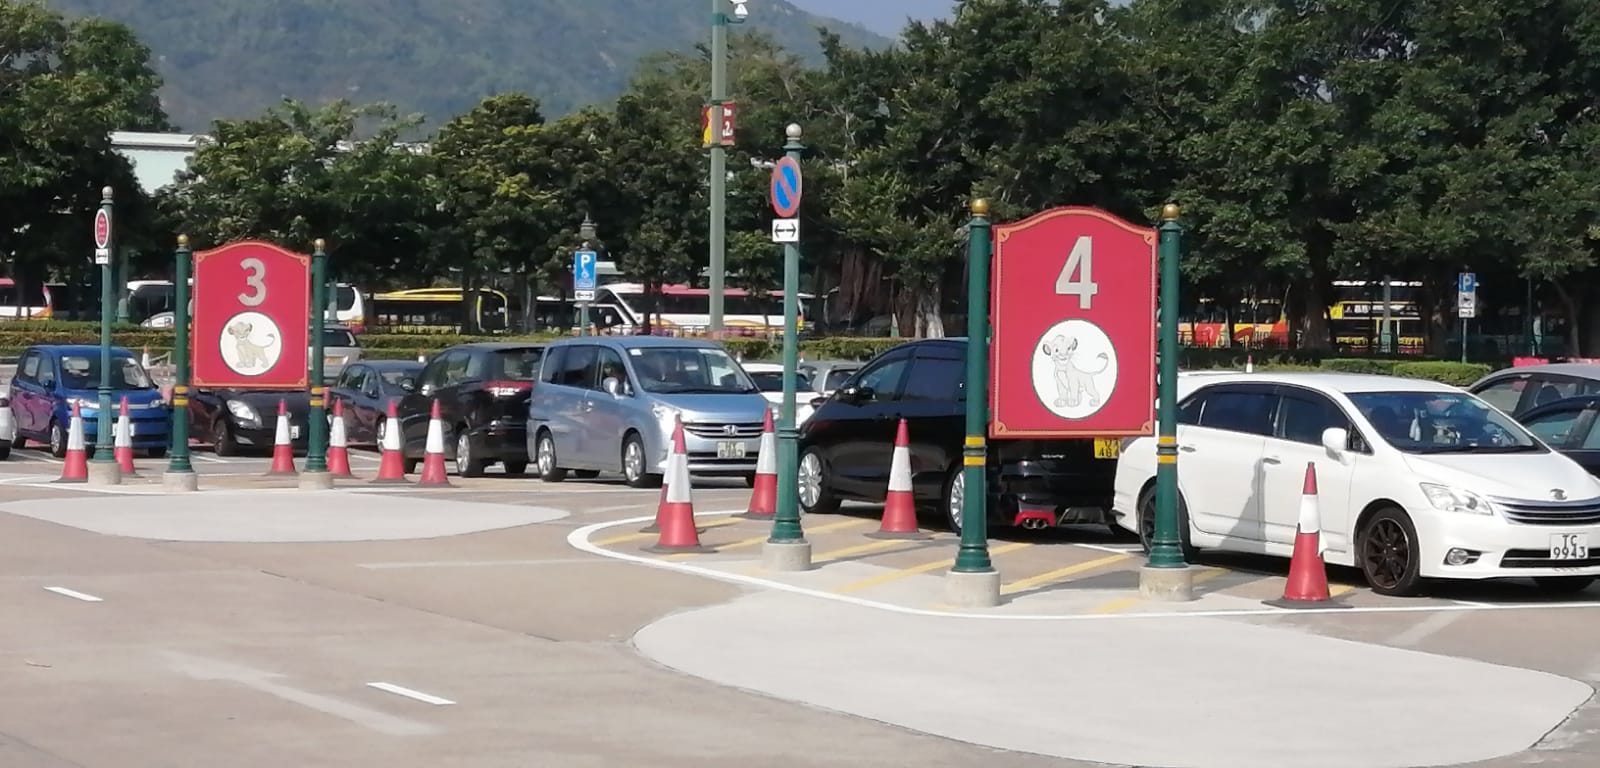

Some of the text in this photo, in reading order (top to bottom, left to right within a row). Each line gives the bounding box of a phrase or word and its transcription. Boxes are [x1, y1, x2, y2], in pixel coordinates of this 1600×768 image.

[581, 254, 591, 268] P
[1055, 235, 1099, 310] 4
[237, 257, 267, 307] 3
[1463, 276, 1472, 291] P
[1562, 534, 1577, 547] TC
[1553, 546, 1586, 558] 9943
